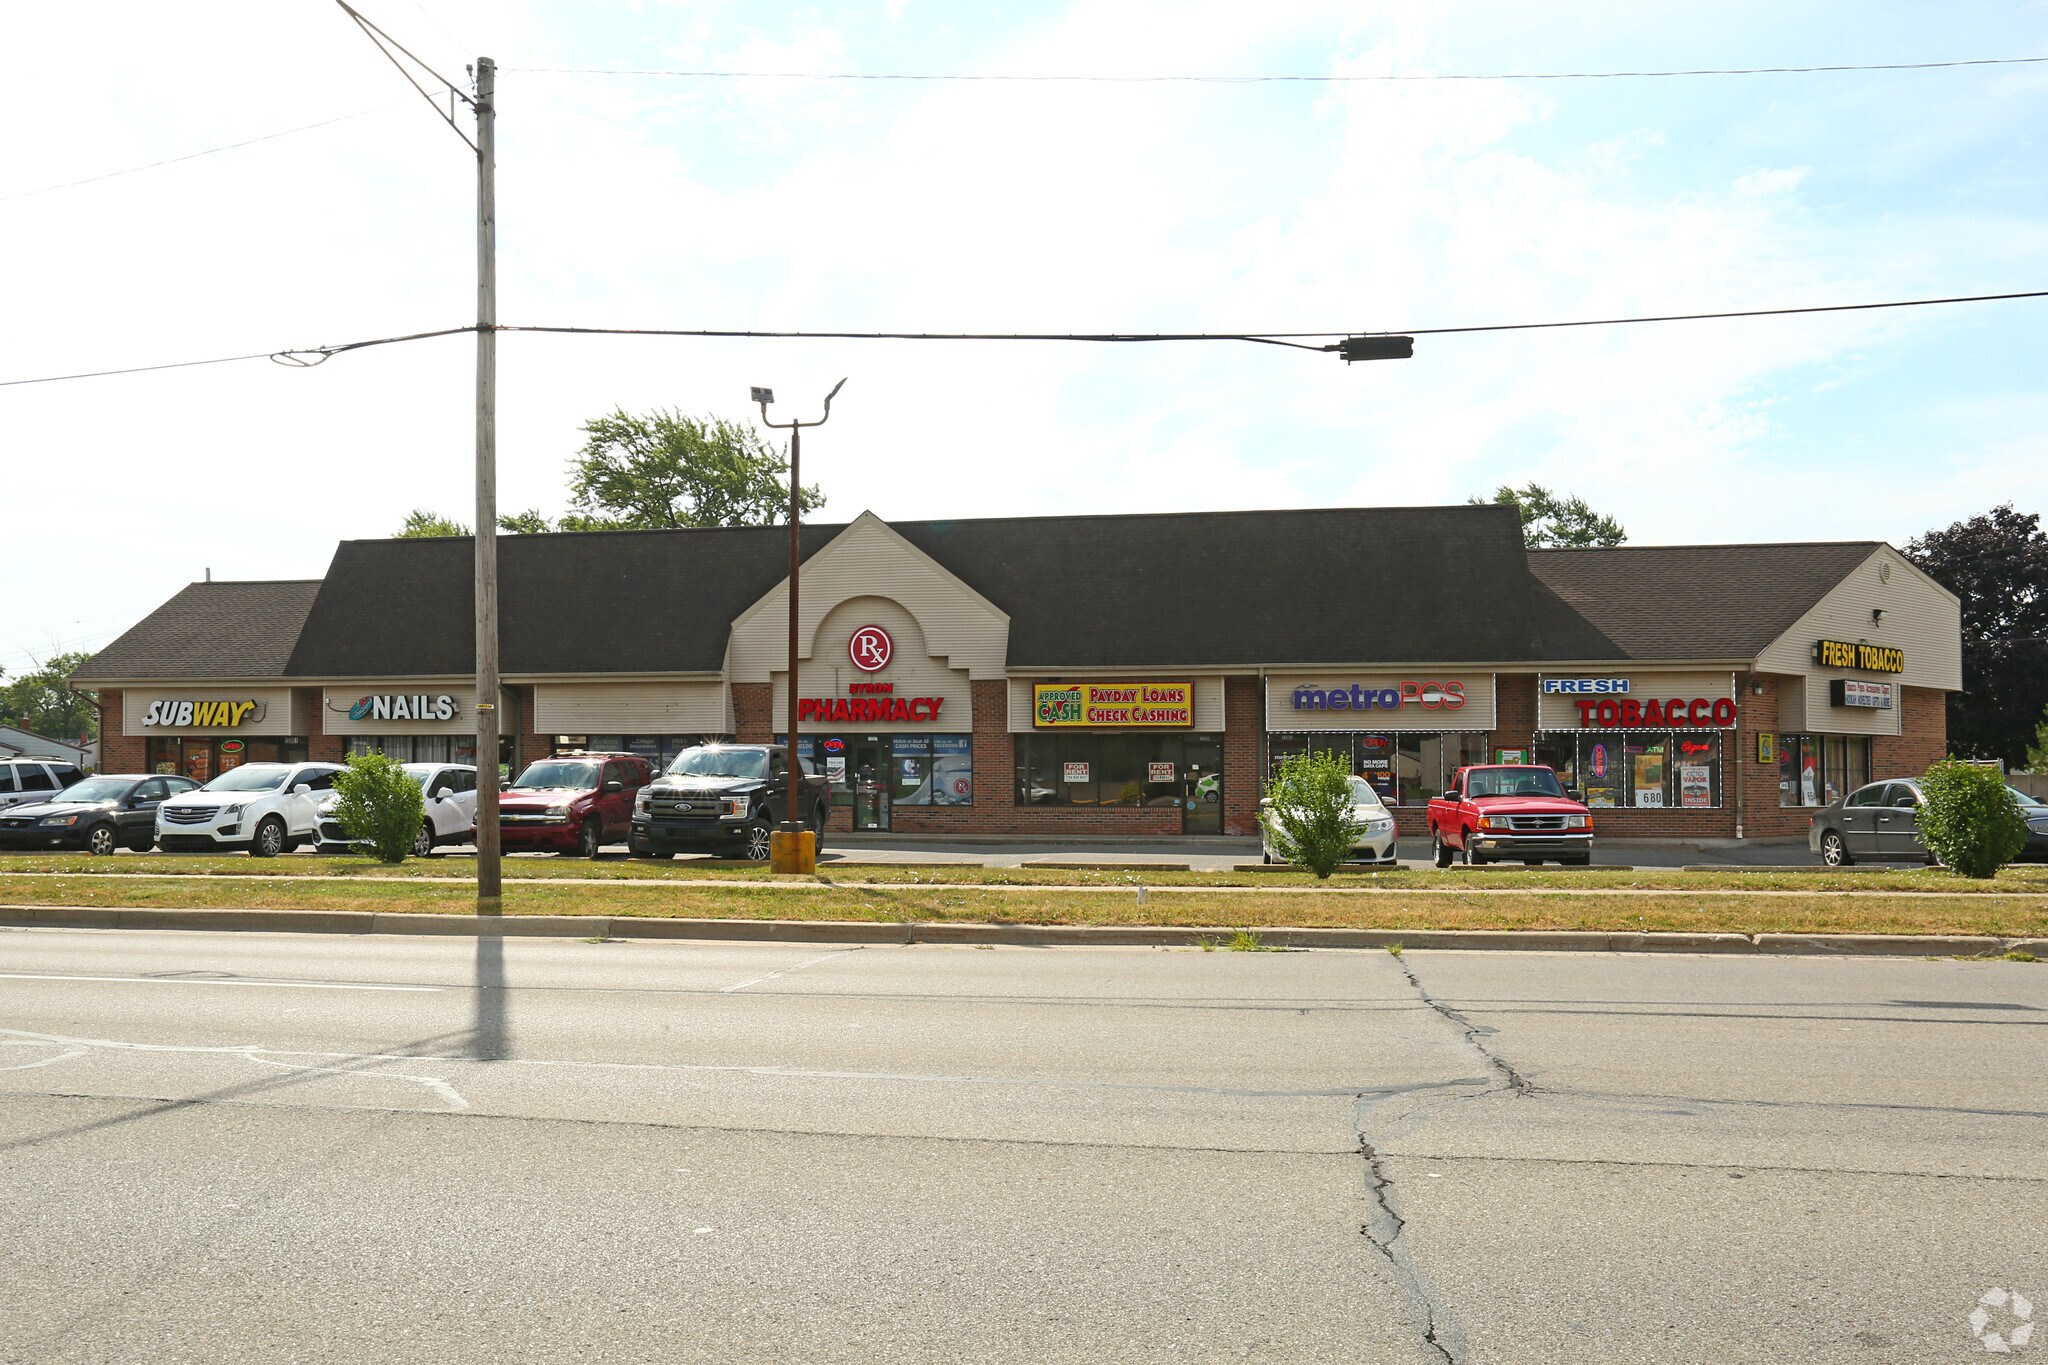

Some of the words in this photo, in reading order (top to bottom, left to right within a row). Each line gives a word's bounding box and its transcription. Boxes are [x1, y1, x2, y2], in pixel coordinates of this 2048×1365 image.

[1822, 641, 1856, 667] FRESH
[1859, 645, 1903, 673] TOBACCO
[849, 683, 894, 694] BYRON
[1544, 679, 1630, 693] FRESH
[1038, 691, 1082, 701] APPROVED
[1089, 687, 1138, 703] PAYDAY
[1142, 687, 1184, 702] LOANS
[1293, 680, 1466, 711] metroPCS
[141, 699, 256, 727] SUBWAY
[373, 695, 453, 720] NAILS
[798, 697, 944, 722] PHARMACY
[1038, 702, 1082, 721] CASH
[1086, 706, 1130, 722] CHECK
[1131, 706, 1188, 723] CASHING
[1575, 698, 1736, 728] TOBACCO
[824, 741, 845, 749] OPEN
[1363, 737, 1389, 748] OPEN
[1643, 793, 1662, 803] 680
